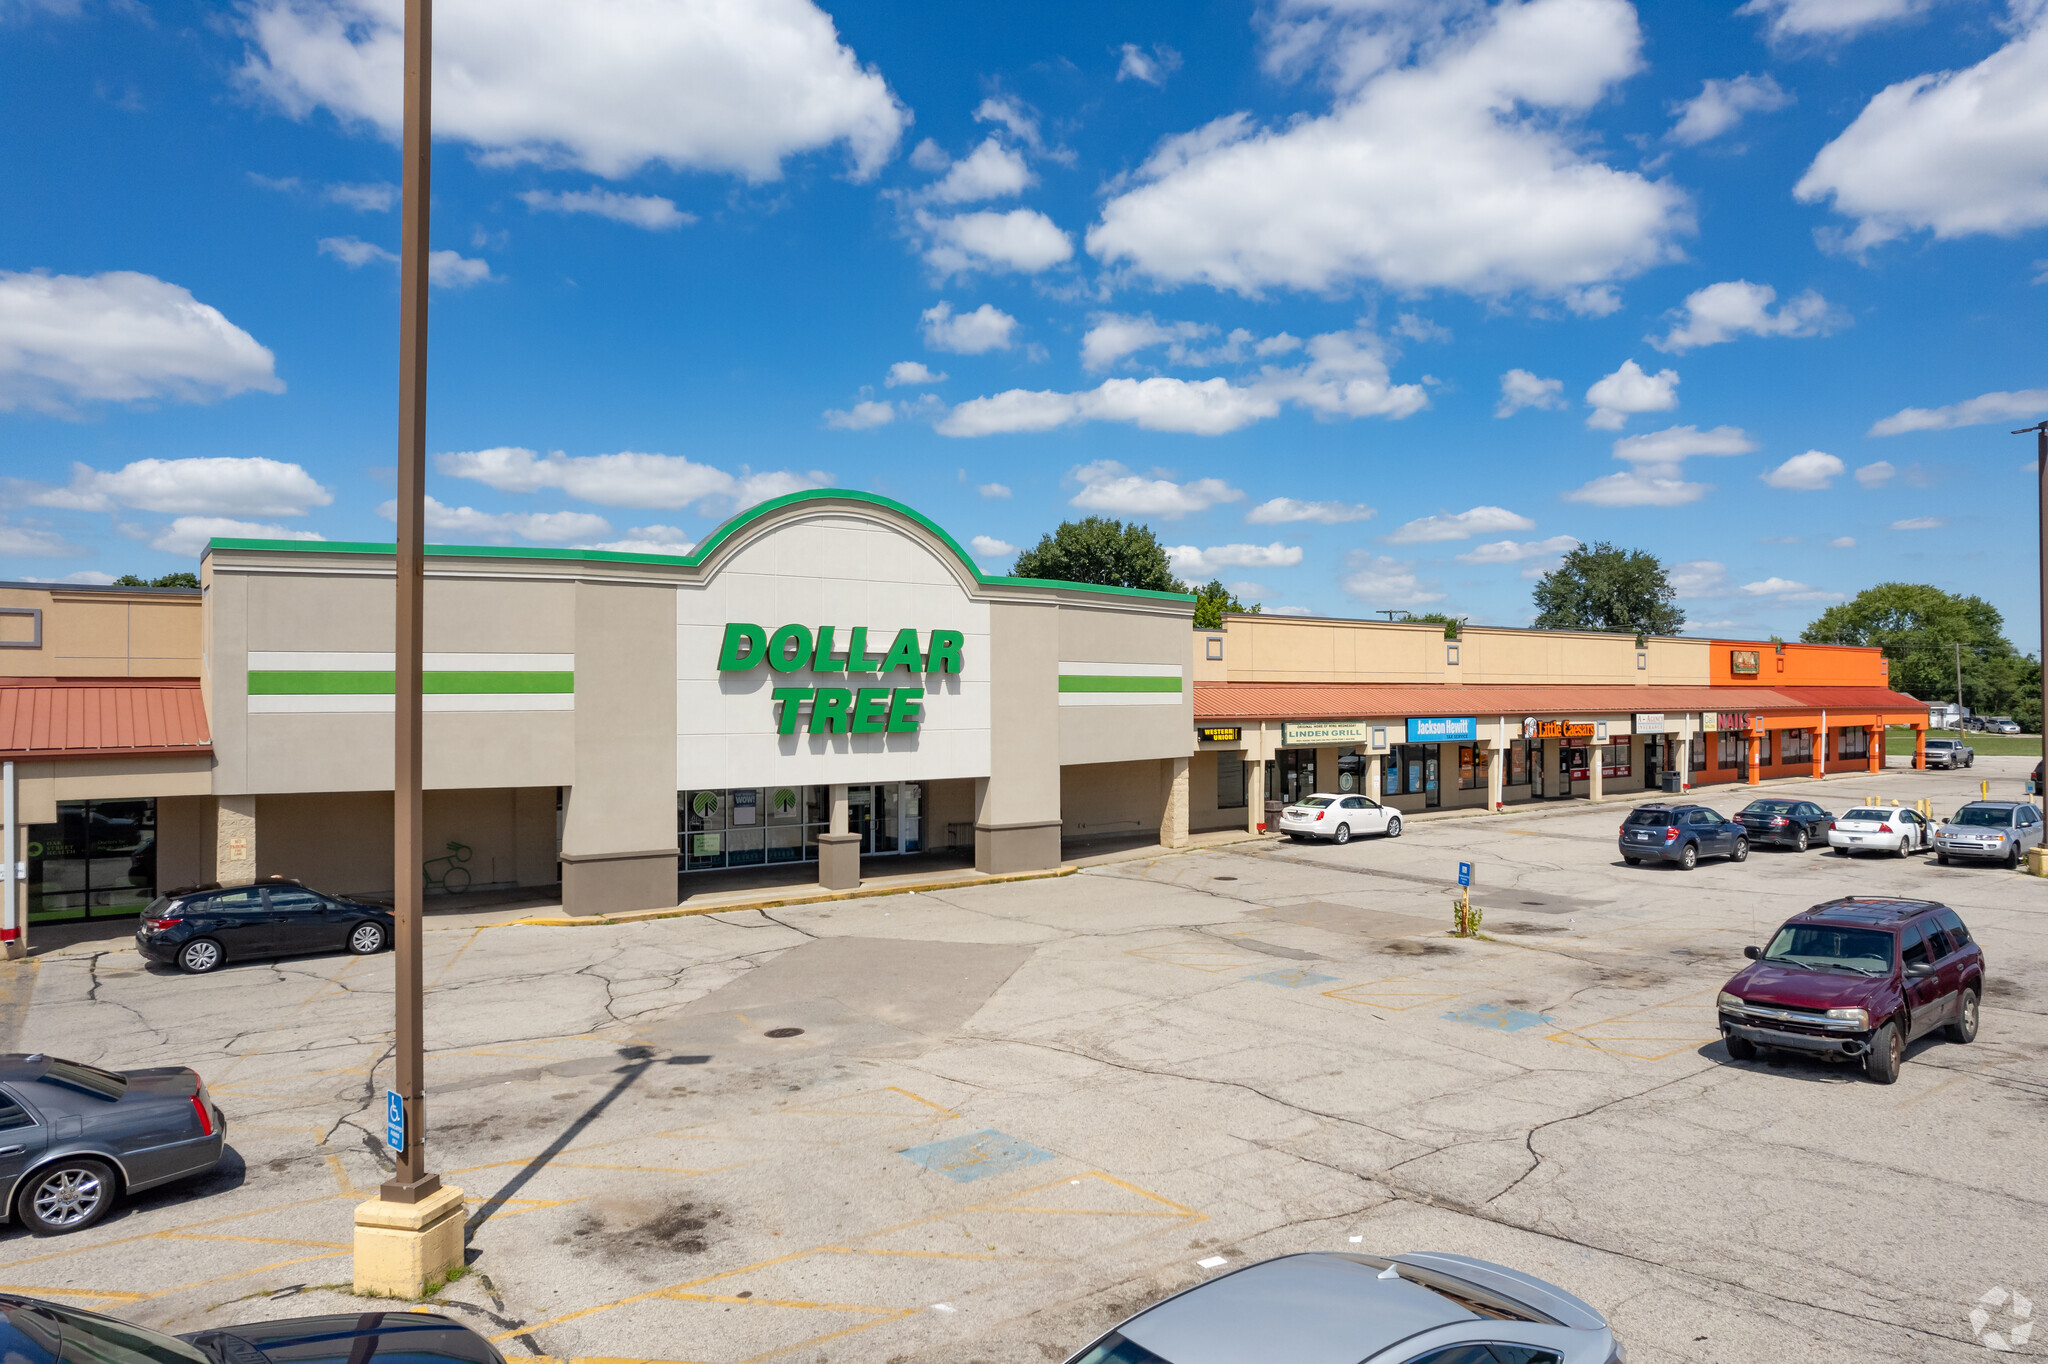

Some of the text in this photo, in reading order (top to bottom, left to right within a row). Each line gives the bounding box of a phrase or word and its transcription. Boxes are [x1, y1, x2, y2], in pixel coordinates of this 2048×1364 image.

[717, 623, 964, 673] DOLLAR
[771, 687, 925, 735] TREE
[1418, 719, 1468, 734] Jackson Hewitt
[1538, 720, 1595, 737] Little Caesars
[1718, 713, 1750, 728] NAILS
